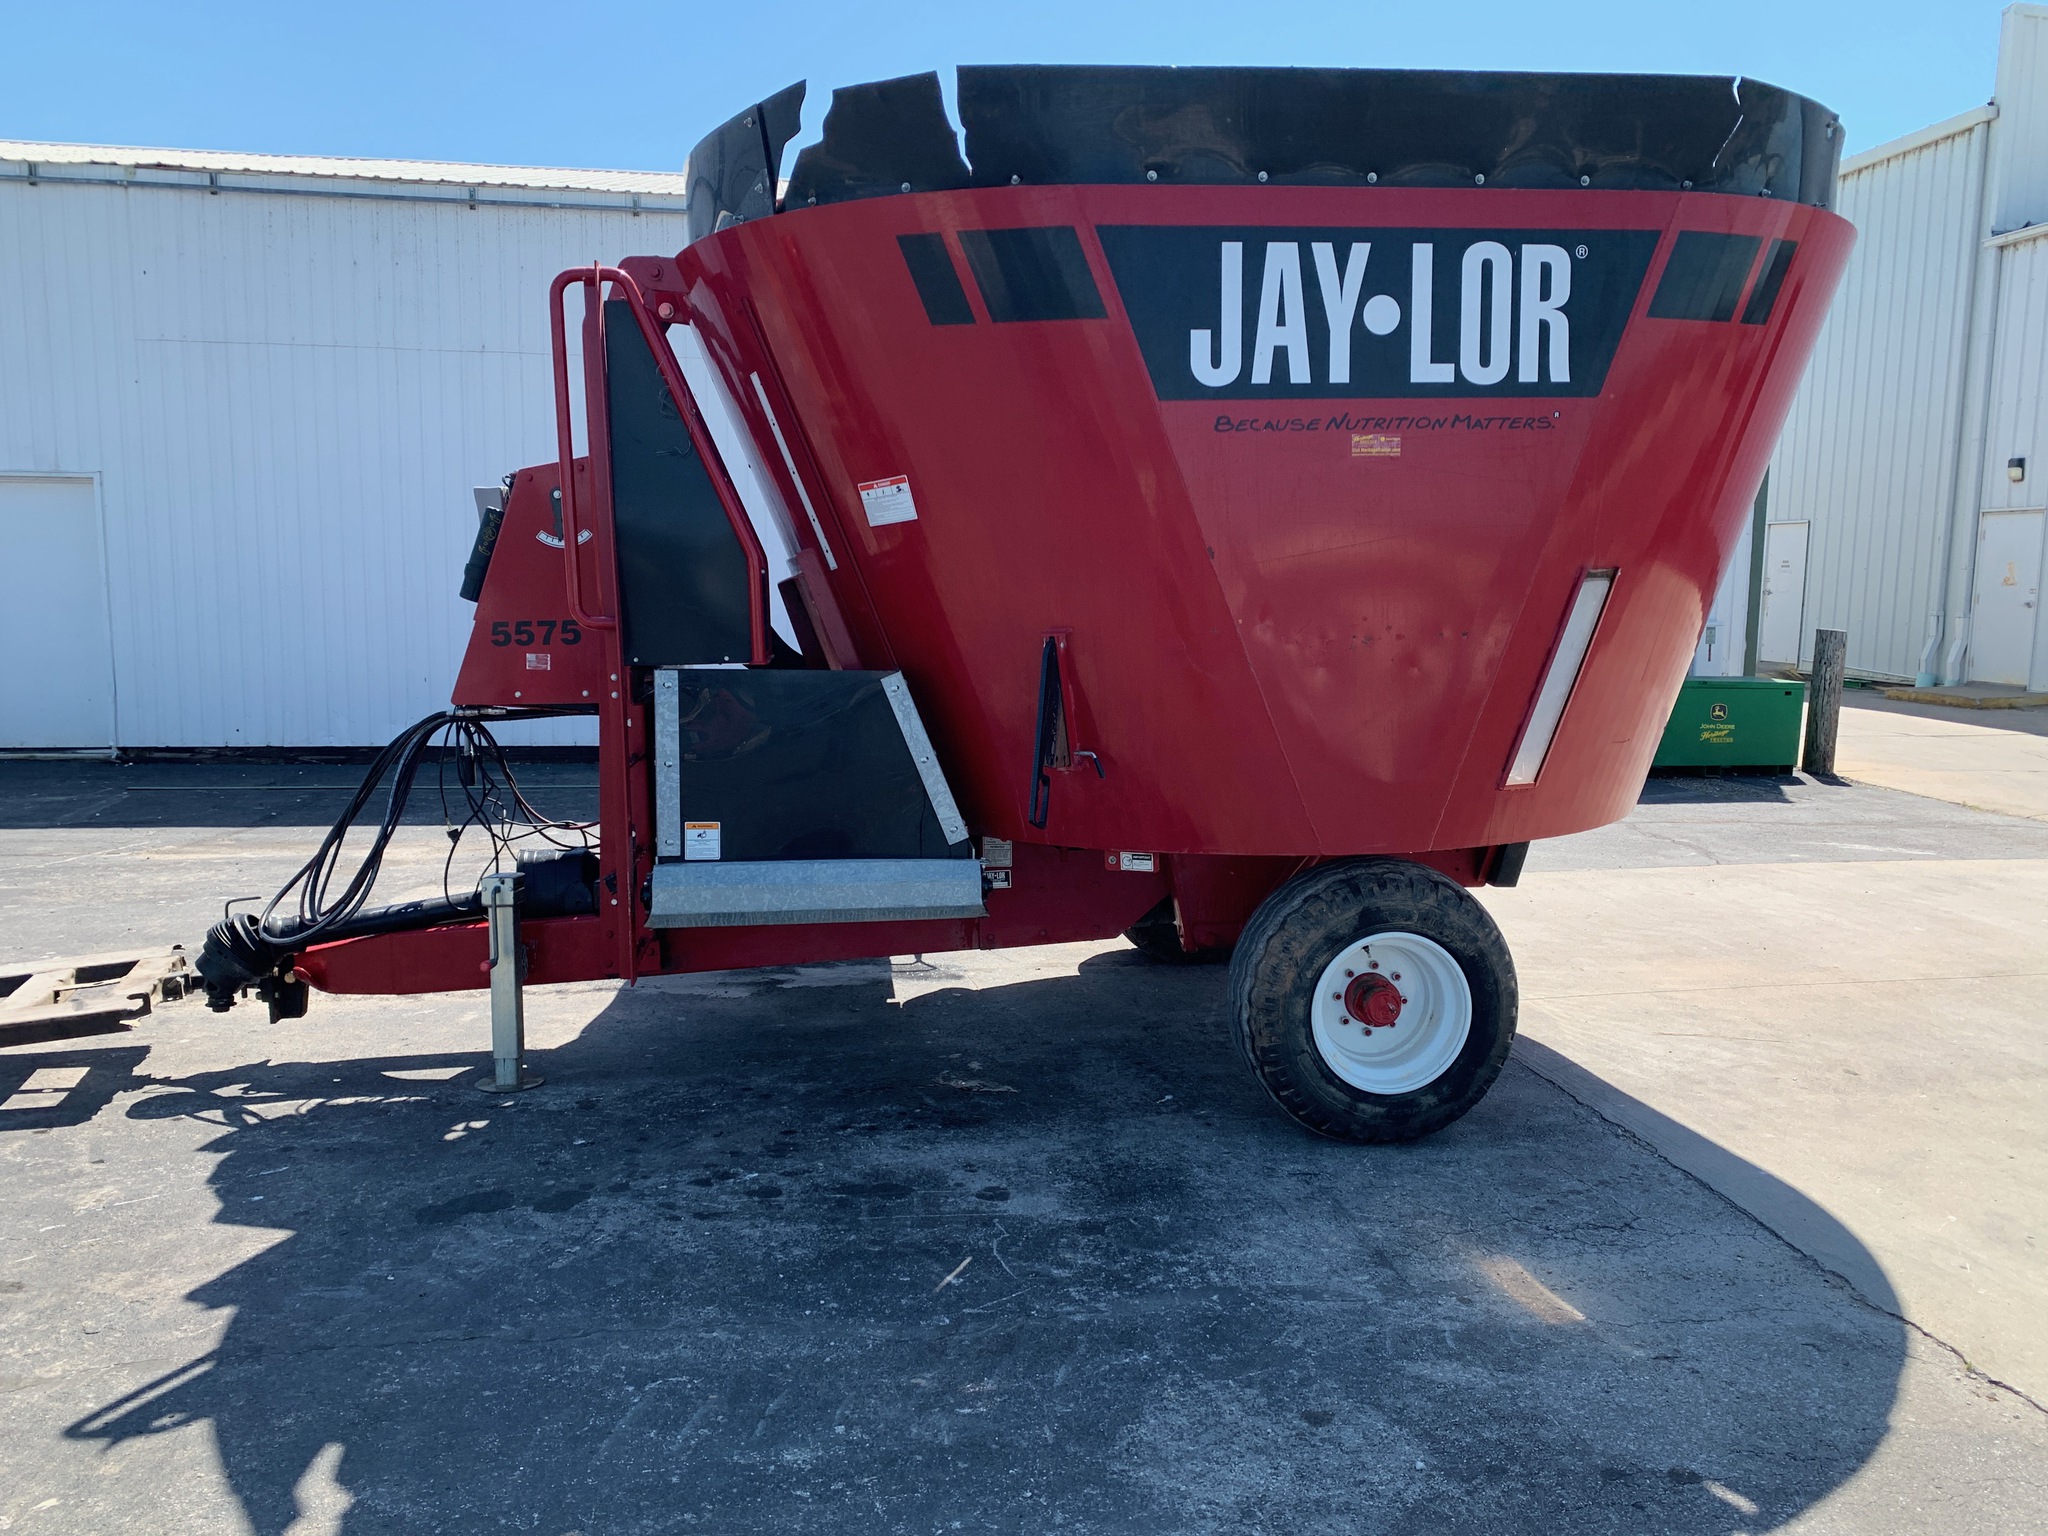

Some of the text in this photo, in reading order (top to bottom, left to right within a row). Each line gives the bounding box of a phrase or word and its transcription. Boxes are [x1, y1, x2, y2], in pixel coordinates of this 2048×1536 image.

[1214, 415, 1321, 432] BECAUSE
[1325, 412, 1448, 430] NUTRITION
[490, 619, 582, 647] 5575
